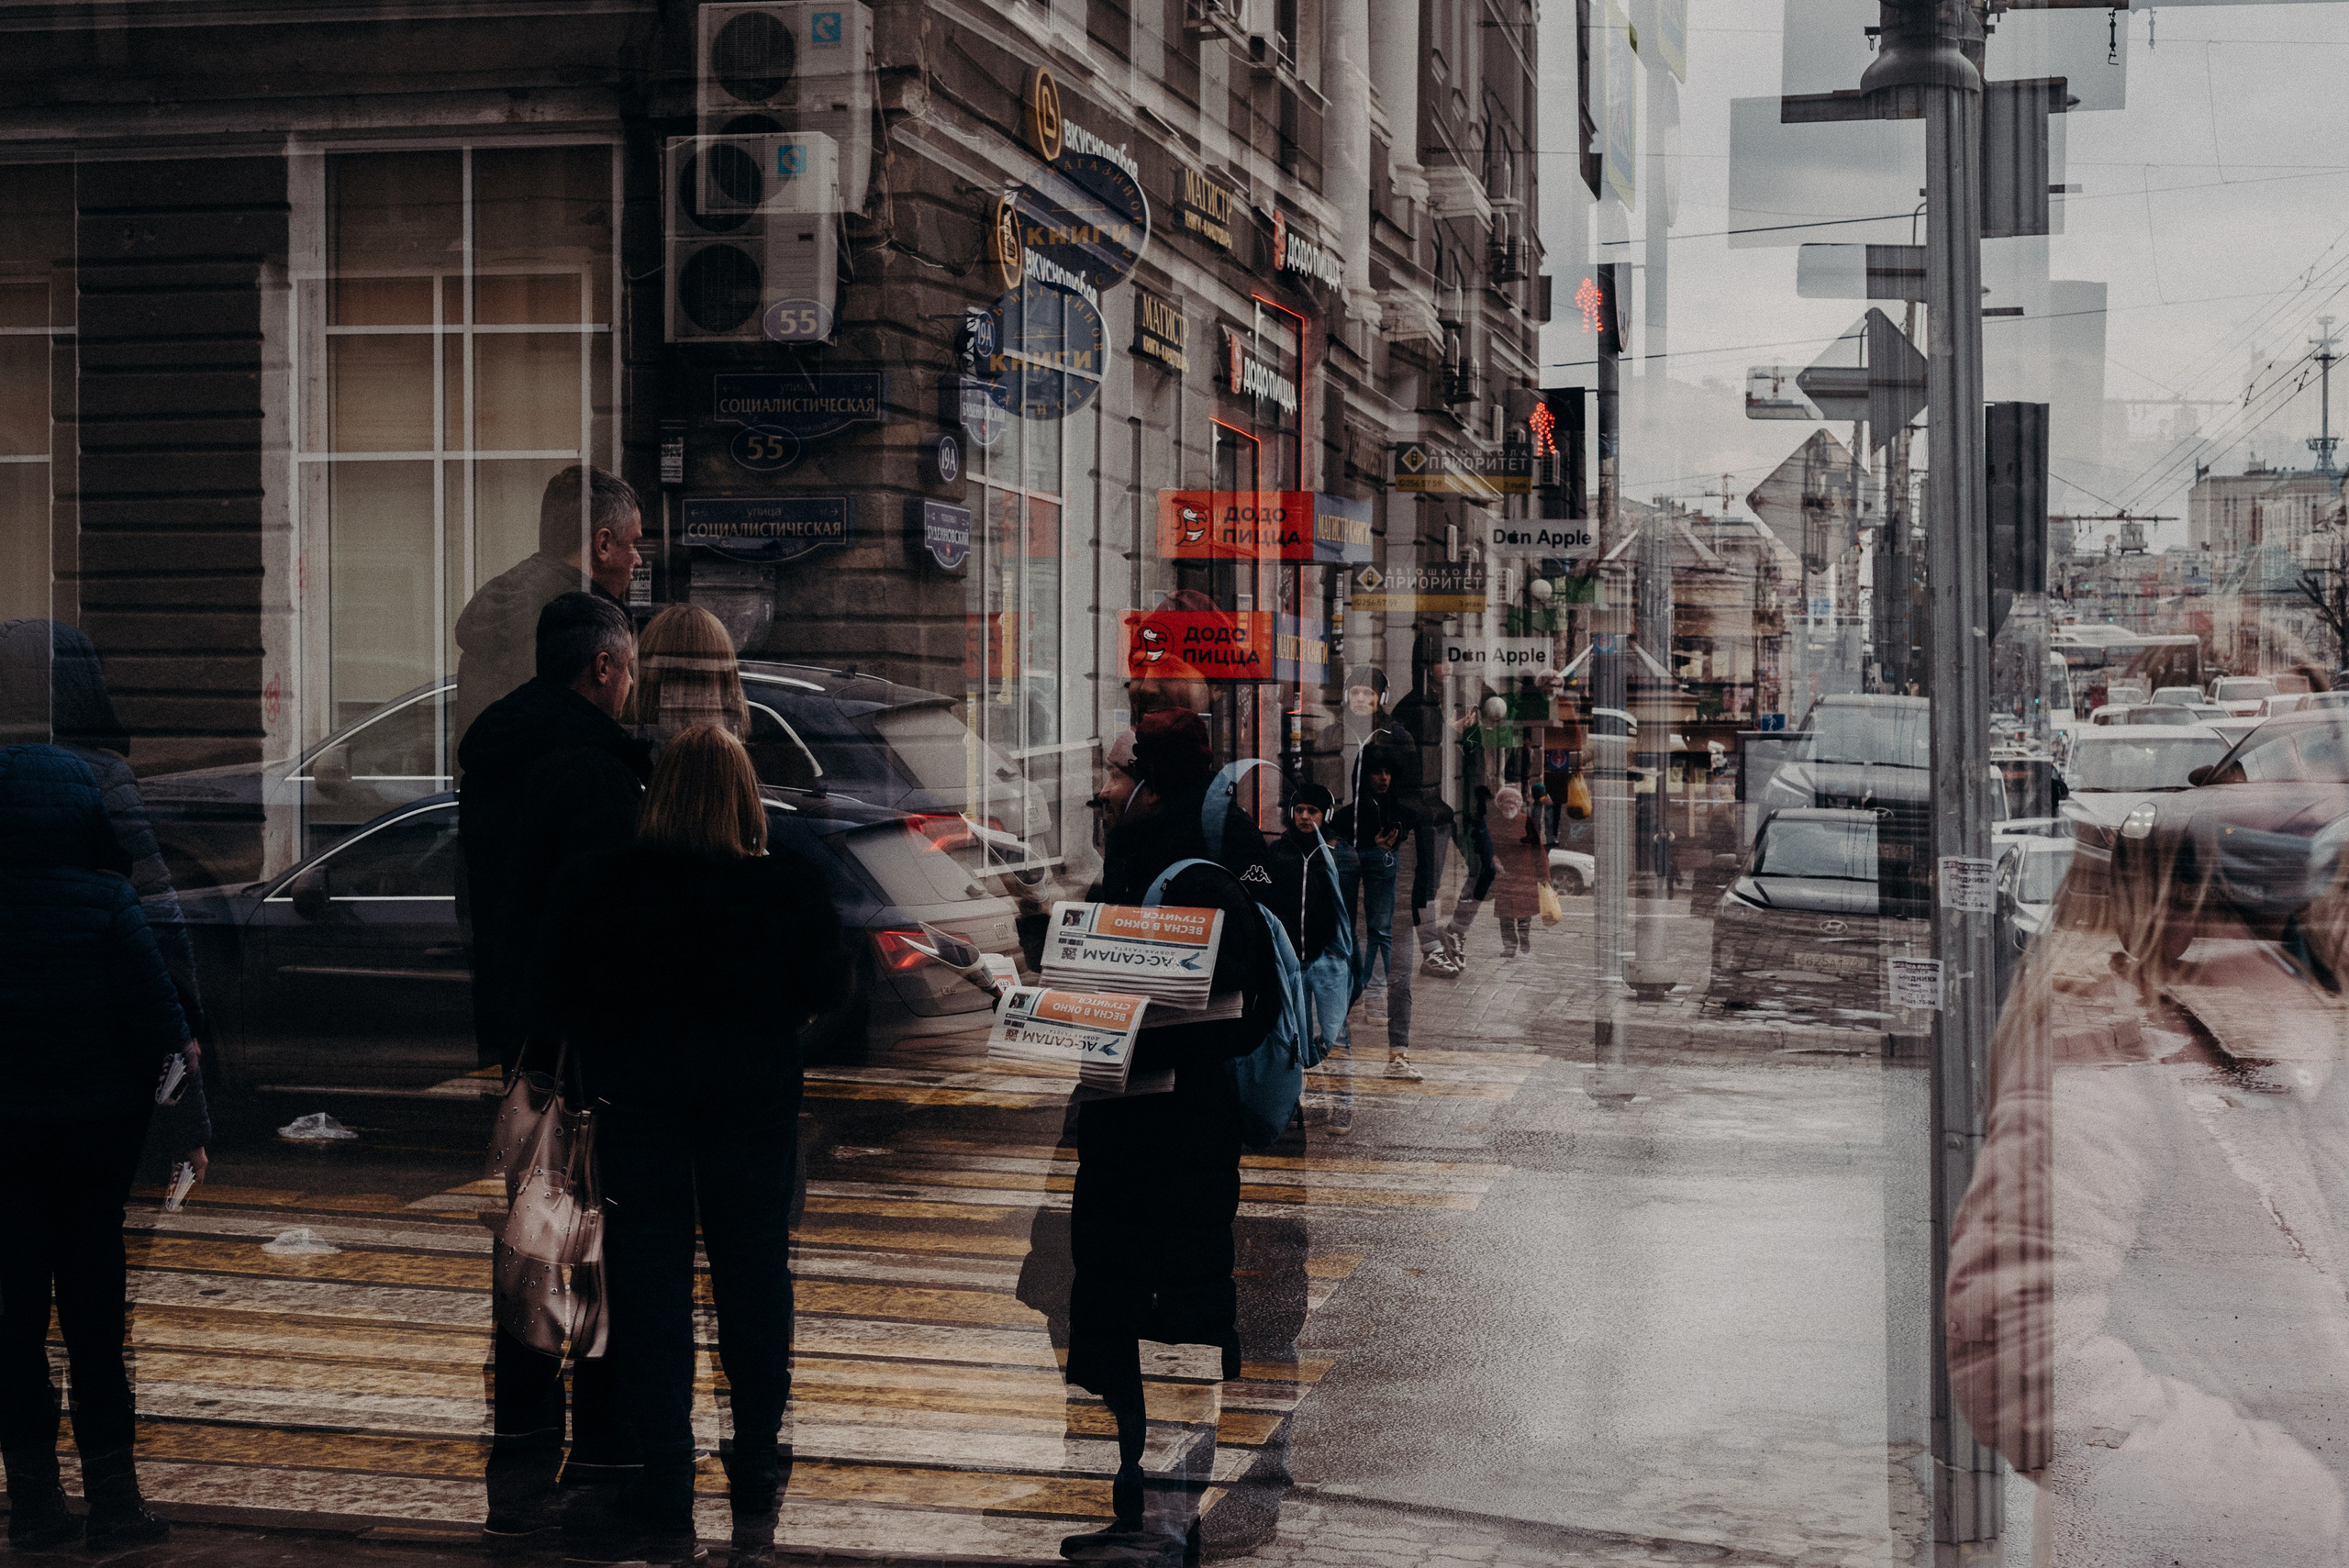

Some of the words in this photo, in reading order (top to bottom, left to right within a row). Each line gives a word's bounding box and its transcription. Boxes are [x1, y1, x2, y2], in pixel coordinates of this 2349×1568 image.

[1185, 168, 1232, 225] МАГИСТР
[1026, 224, 1131, 246] КНИГИ
[780, 309, 818, 334] 55
[1142, 293, 1189, 349] МАГИСТР
[988, 350, 1092, 372] КНИГИ
[718, 396, 875, 414] СОЦИАЛИСТИЧЕСКАЯ
[747, 436, 785, 460] 55
[941, 446, 957, 472] 19А
[1429, 457, 1528, 471] ПРИОРИТЕТ
[746, 506, 781, 517] улица
[1224, 506, 1286, 524] ДОДО
[688, 521, 842, 539] СОЦИАЛИСТИЧЕСКАЯ
[927, 525, 969, 546] БУДЕННОВСКИЙ
[1223, 528, 1301, 548] ПИЦЦА
[1537, 528, 1592, 549] Apple
[1386, 568, 1483, 576] АВТОШКОЛА
[1385, 576, 1483, 590] ПРИОРИТЕТ
[1184, 627, 1246, 643] ДОДО
[1183, 649, 1260, 666] ПИЦЦА
[1492, 647, 1546, 667] Apple
[1114, 917, 1150, 929] ОКНО
[1152, 921, 1161, 931] В
[1163, 923, 1204, 936] ВЕСНА
[1052, 1002, 1083, 1014] ОКНО
[1084, 1006, 1092, 1016] В
[1093, 1009, 1127, 1022] ВЕСНА
[1021, 1030, 1098, 1052] АС-САЛАМ
